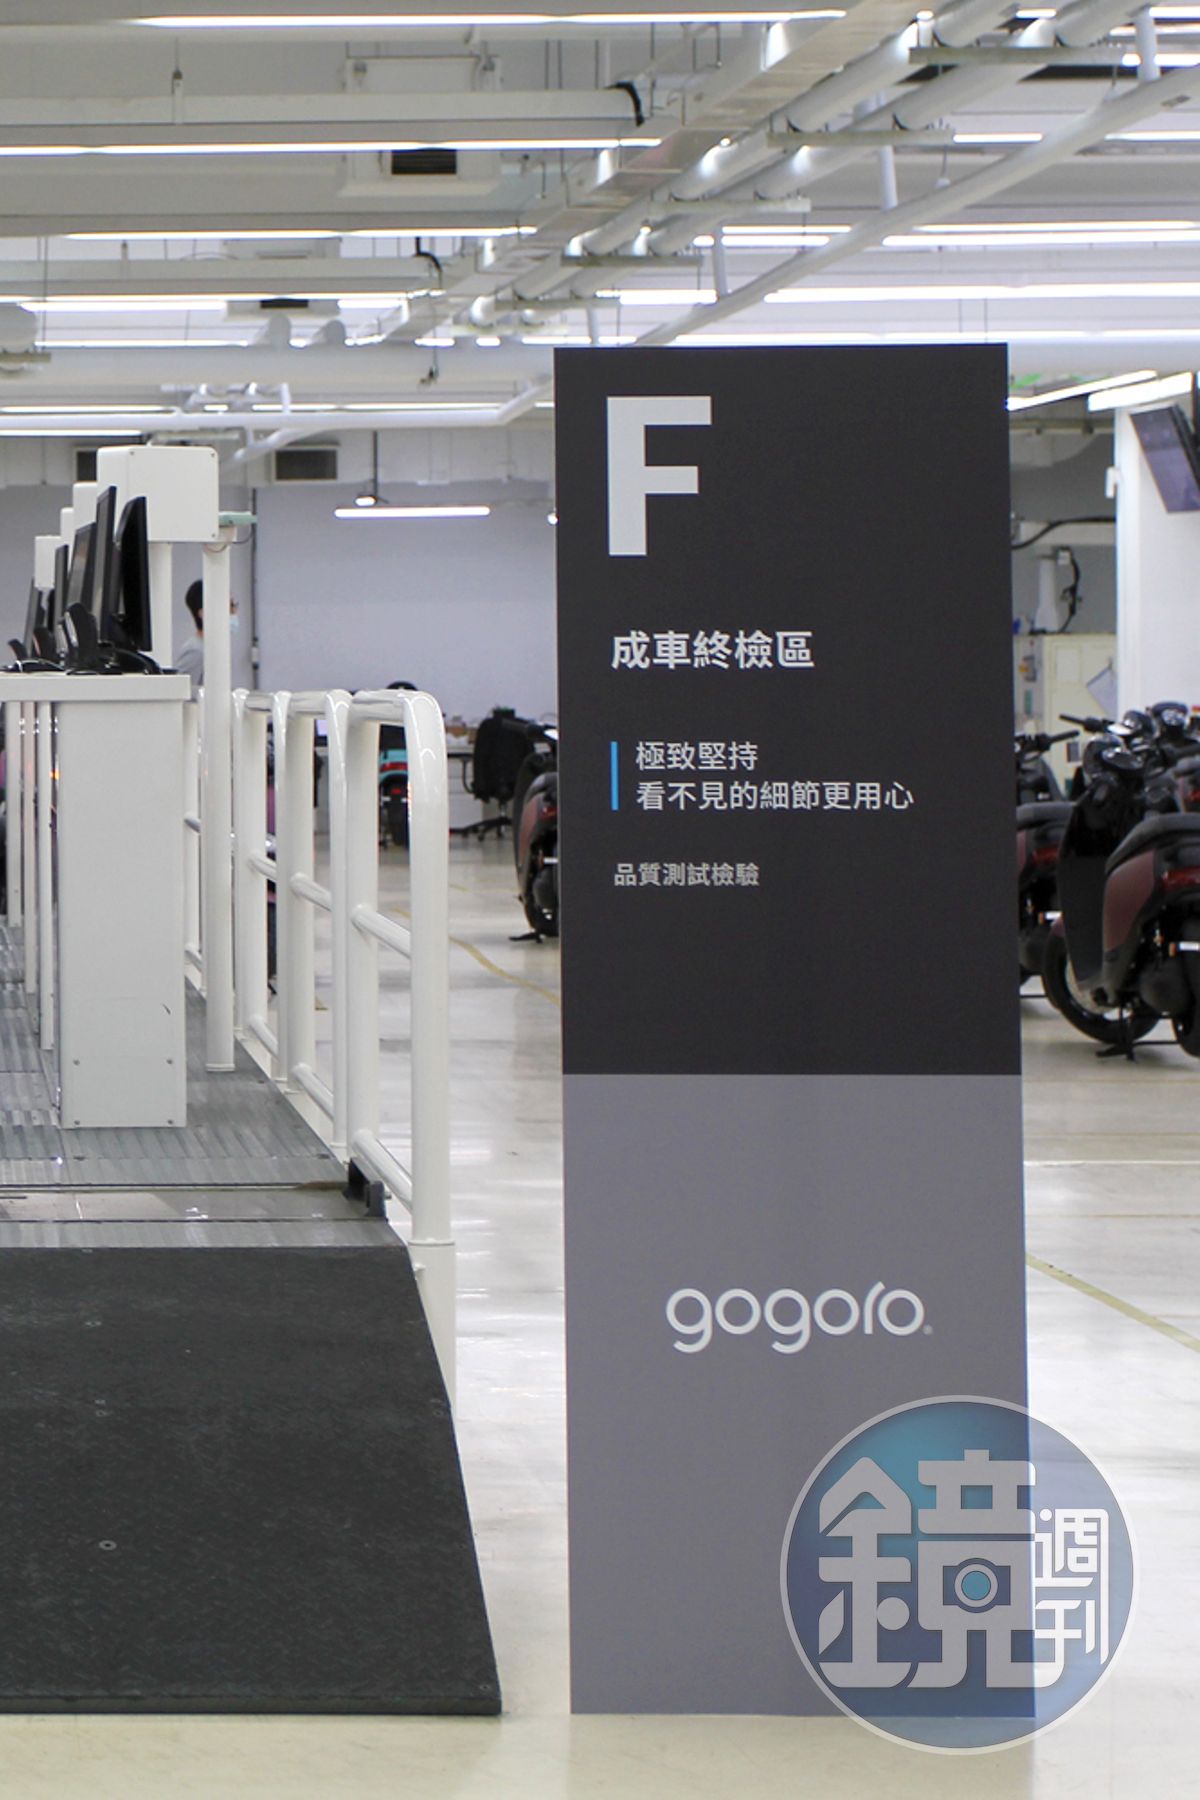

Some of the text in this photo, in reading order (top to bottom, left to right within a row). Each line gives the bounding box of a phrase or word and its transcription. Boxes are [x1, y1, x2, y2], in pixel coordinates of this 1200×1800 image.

[606, 395, 712, 556] F
[611, 629, 816, 670] 成車終檢區
[635, 740, 759, 771] 極致堅持
[636, 780, 915, 811] 看不見的細節更用心
[613, 861, 760, 887] 品質測試檢驗
[665, 1281, 926, 1354] gogoro
